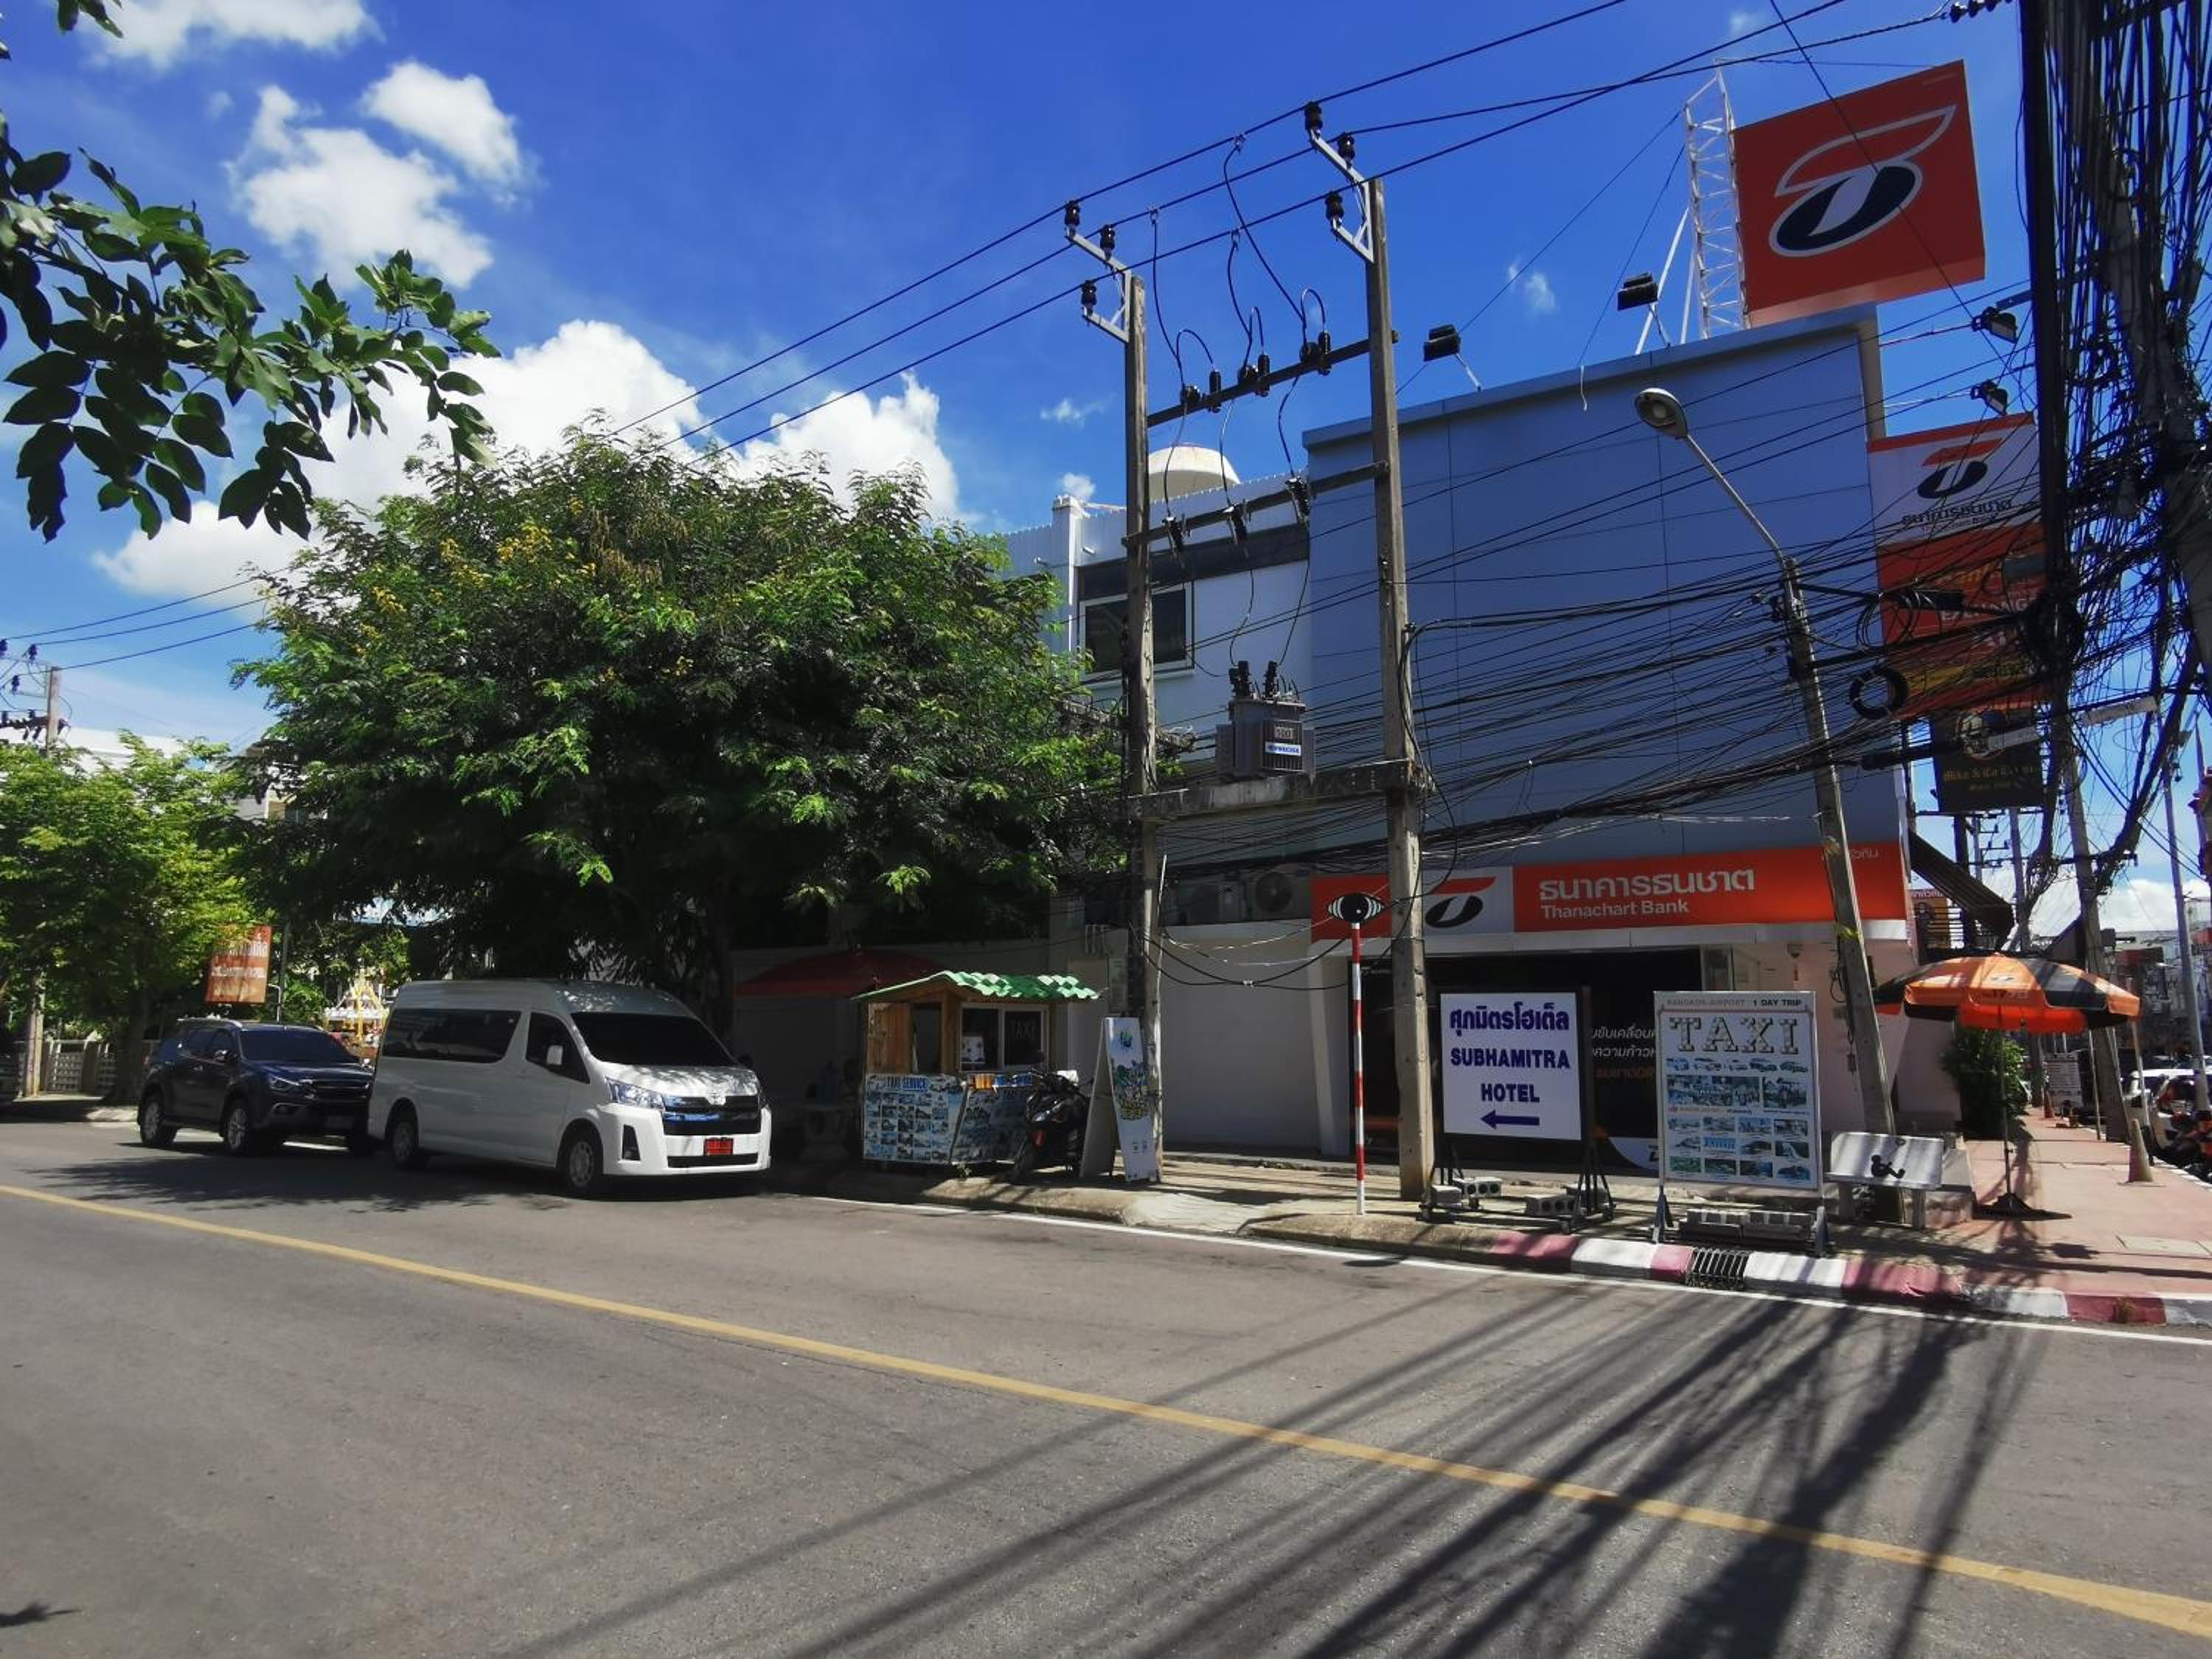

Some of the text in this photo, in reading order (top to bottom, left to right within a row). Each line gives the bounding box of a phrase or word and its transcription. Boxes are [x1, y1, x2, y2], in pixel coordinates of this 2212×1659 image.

[1539, 869, 1756, 900] ธนาคารธนชาต
[1541, 898, 1690, 919] Thanachart Bank
[1669, 1017, 1799, 1054] TAXI
[1450, 1047, 1571, 1068] SUBHAMITRA
[1481, 1082, 1540, 1103] HOTEL
